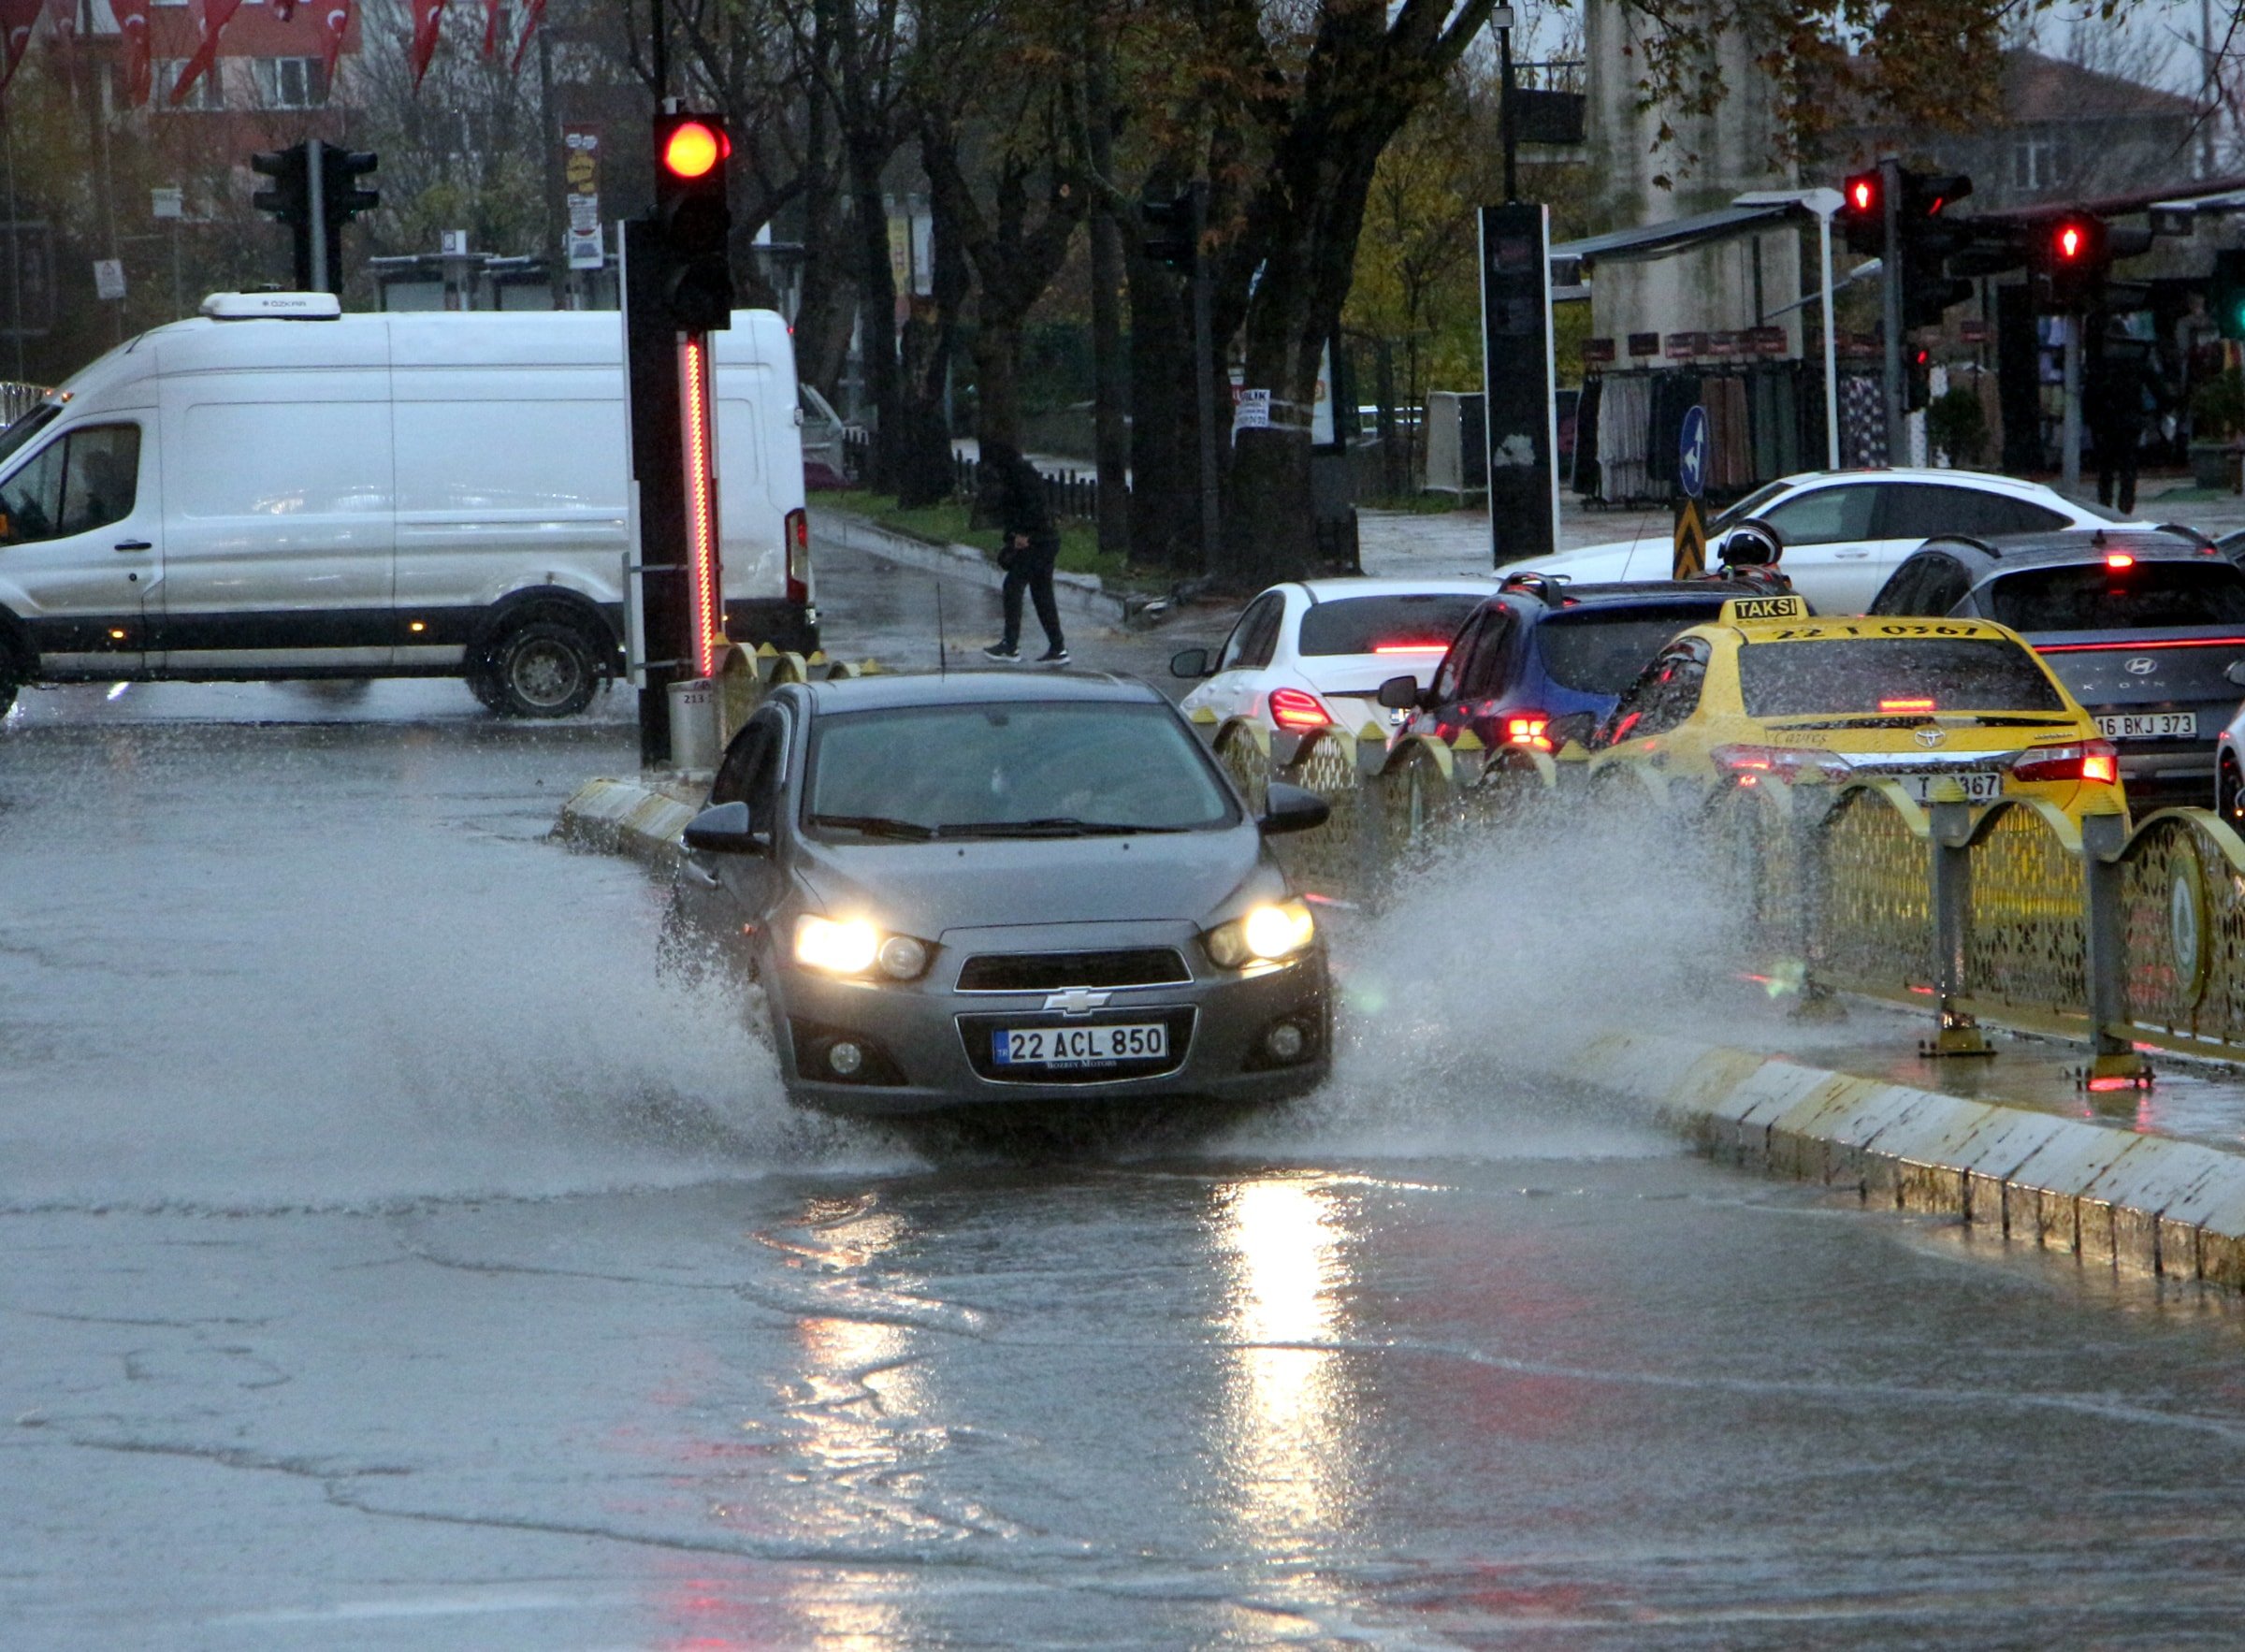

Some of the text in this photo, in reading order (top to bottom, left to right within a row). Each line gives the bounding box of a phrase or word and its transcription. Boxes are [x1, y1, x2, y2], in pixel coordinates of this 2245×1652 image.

[1736, 599, 1796, 617] TAKSİ
[1773, 629, 1824, 640] 22
[1880, 625, 1978, 636] 0367
[2098, 716, 2192, 735] 16 BKJ 373
[1919, 776, 1930, 798] T
[1011, 1028, 1162, 1060] 22 ACL 850
